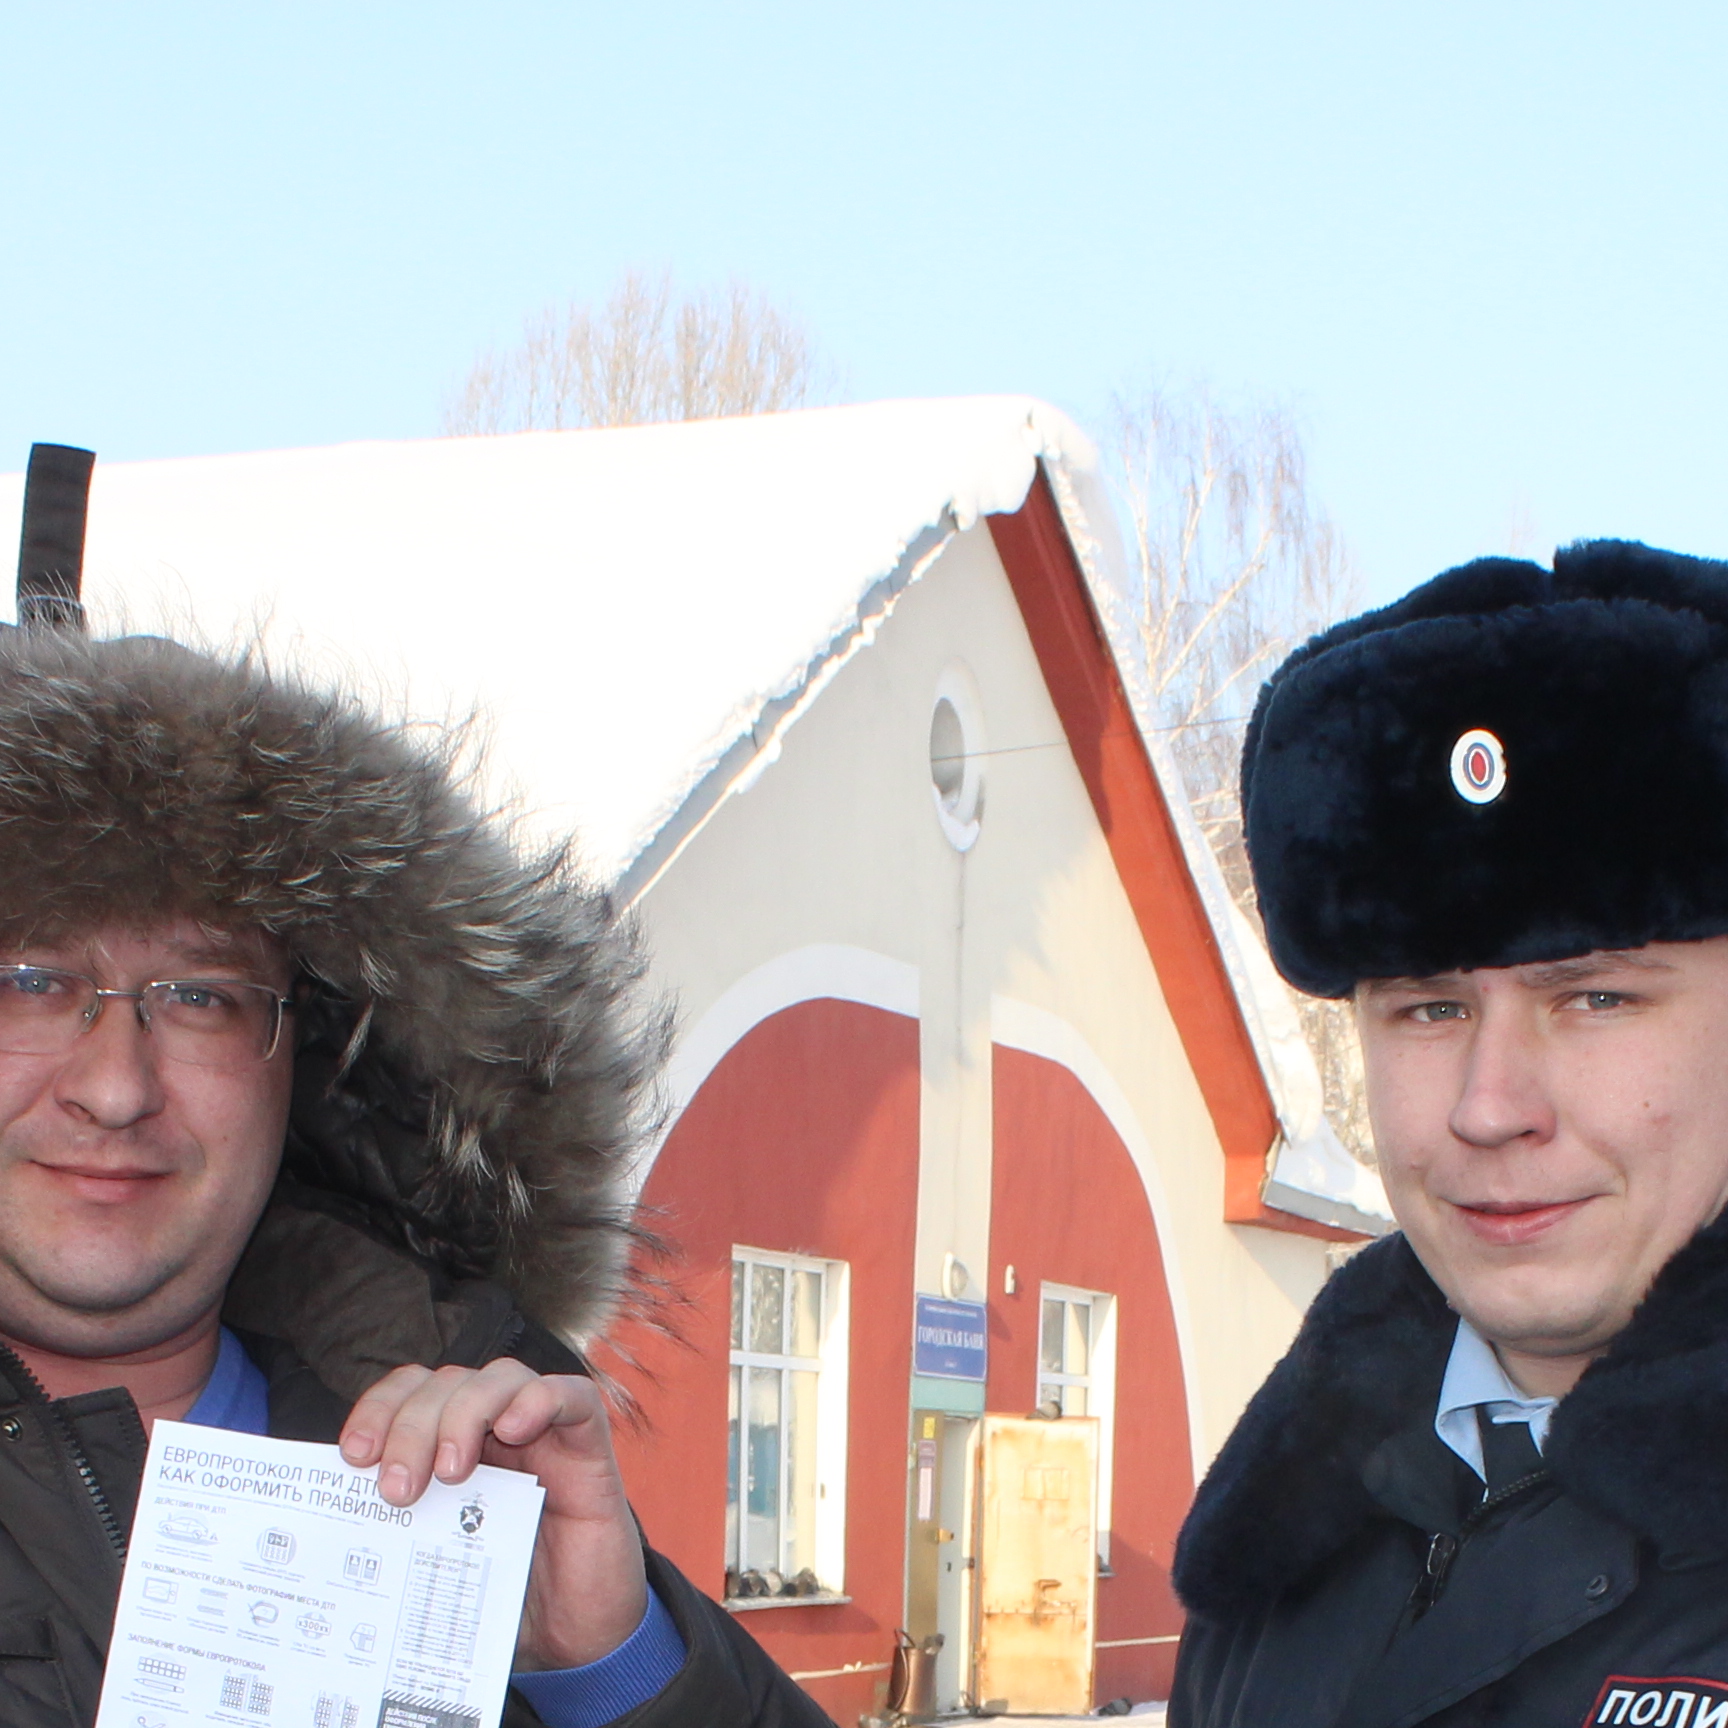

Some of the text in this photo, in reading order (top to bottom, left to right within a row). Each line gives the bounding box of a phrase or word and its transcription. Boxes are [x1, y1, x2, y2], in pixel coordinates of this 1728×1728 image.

[163, 1446, 303, 1481] ЕВРОПРОТОКОЛ
[308, 1469, 343, 1489] ПРИ
[154, 1496, 226, 1515] ДЕЙСТВИЯ ПРИ ДТП
[159, 1466, 196, 1485] КАК
[201, 1473, 303, 1502] ОФОРМИТЬ
[308, 1490, 413, 1528] ПРАВИЛЬНО
[141, 1561, 336, 1611] ПО ВОЗМОЖНОСТИ СДЕЛАТЬ ФОТОГРАФИИ МЕСТА ДТП
[127, 1632, 266, 1673] ЗАПОЛНЕНИЕ ФОРМЫ ЕВРОПРОТОКОЛА
